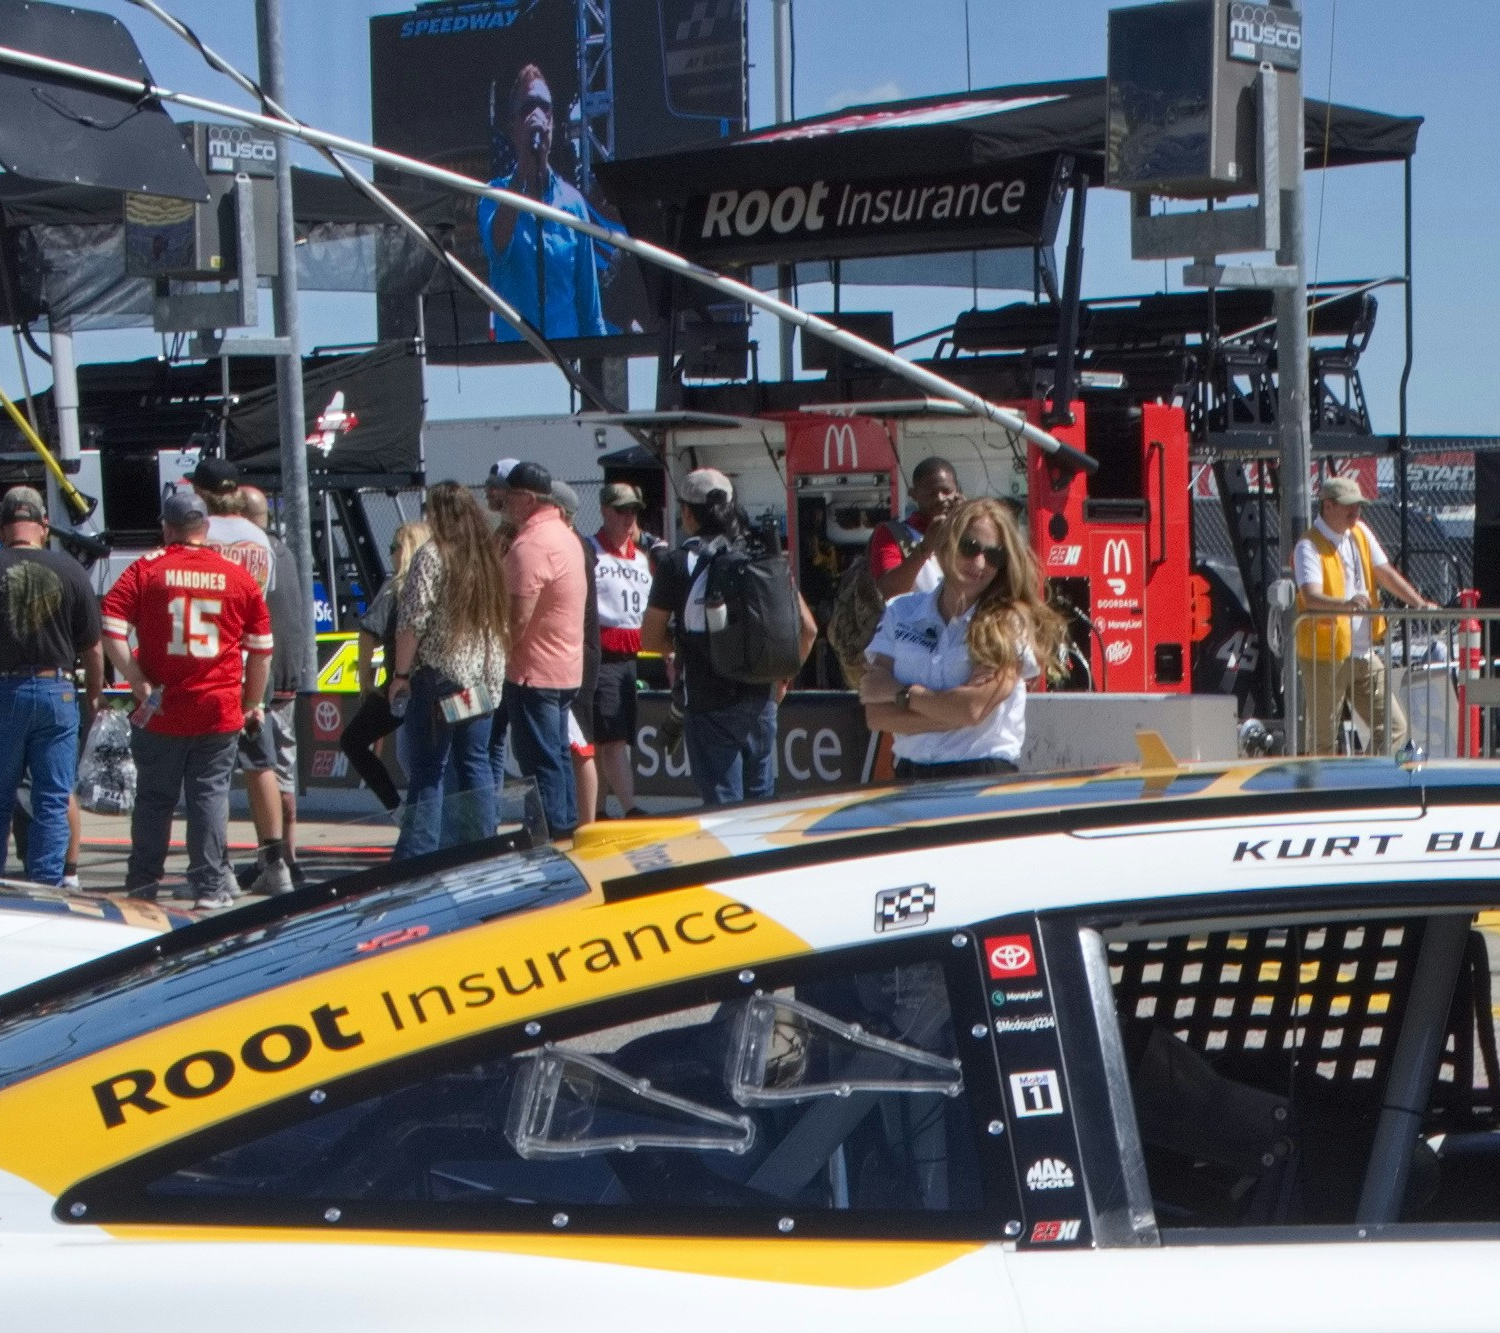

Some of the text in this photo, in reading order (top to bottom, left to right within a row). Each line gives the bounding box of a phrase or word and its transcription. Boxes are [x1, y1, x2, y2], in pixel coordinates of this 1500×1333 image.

[401, 9, 518, 39] SPEEDWAY
[836, 178, 1026, 228] Insurance
[165, 569, 227, 591] MAHOMES
[599, 565, 650, 584] PHOTO
[621, 590, 641, 613] 19
[167, 596, 223, 658] 15
[1232, 833, 1403, 864] KURT
[381, 894, 759, 1033] Insurance
[1006, 990, 1043, 1002] MoneyLion
[1019, 1075, 1049, 1086] Mobil
[1028, 1086, 1044, 1111] 1
[1026, 1158, 1074, 1183] MAC
[1027, 1179, 1075, 1191] TOOLS
